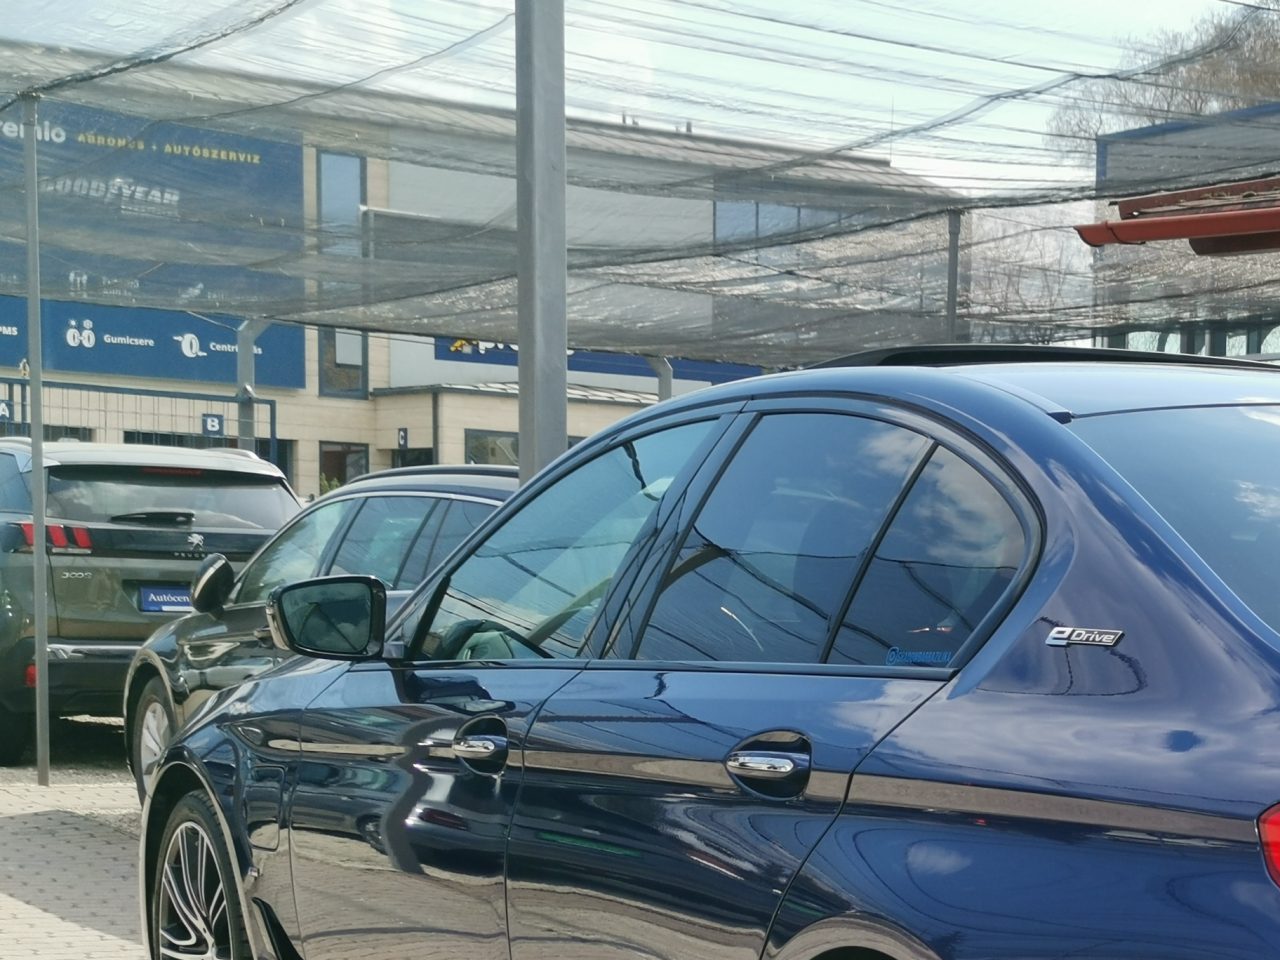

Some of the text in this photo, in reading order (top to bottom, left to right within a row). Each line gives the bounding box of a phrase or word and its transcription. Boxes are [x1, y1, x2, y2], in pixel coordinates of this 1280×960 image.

[103, 334, 155, 347] Gumicsere
[206, 417, 219, 431] B
[399, 430, 405, 445] C
[149, 593, 190, 602] Autócen
